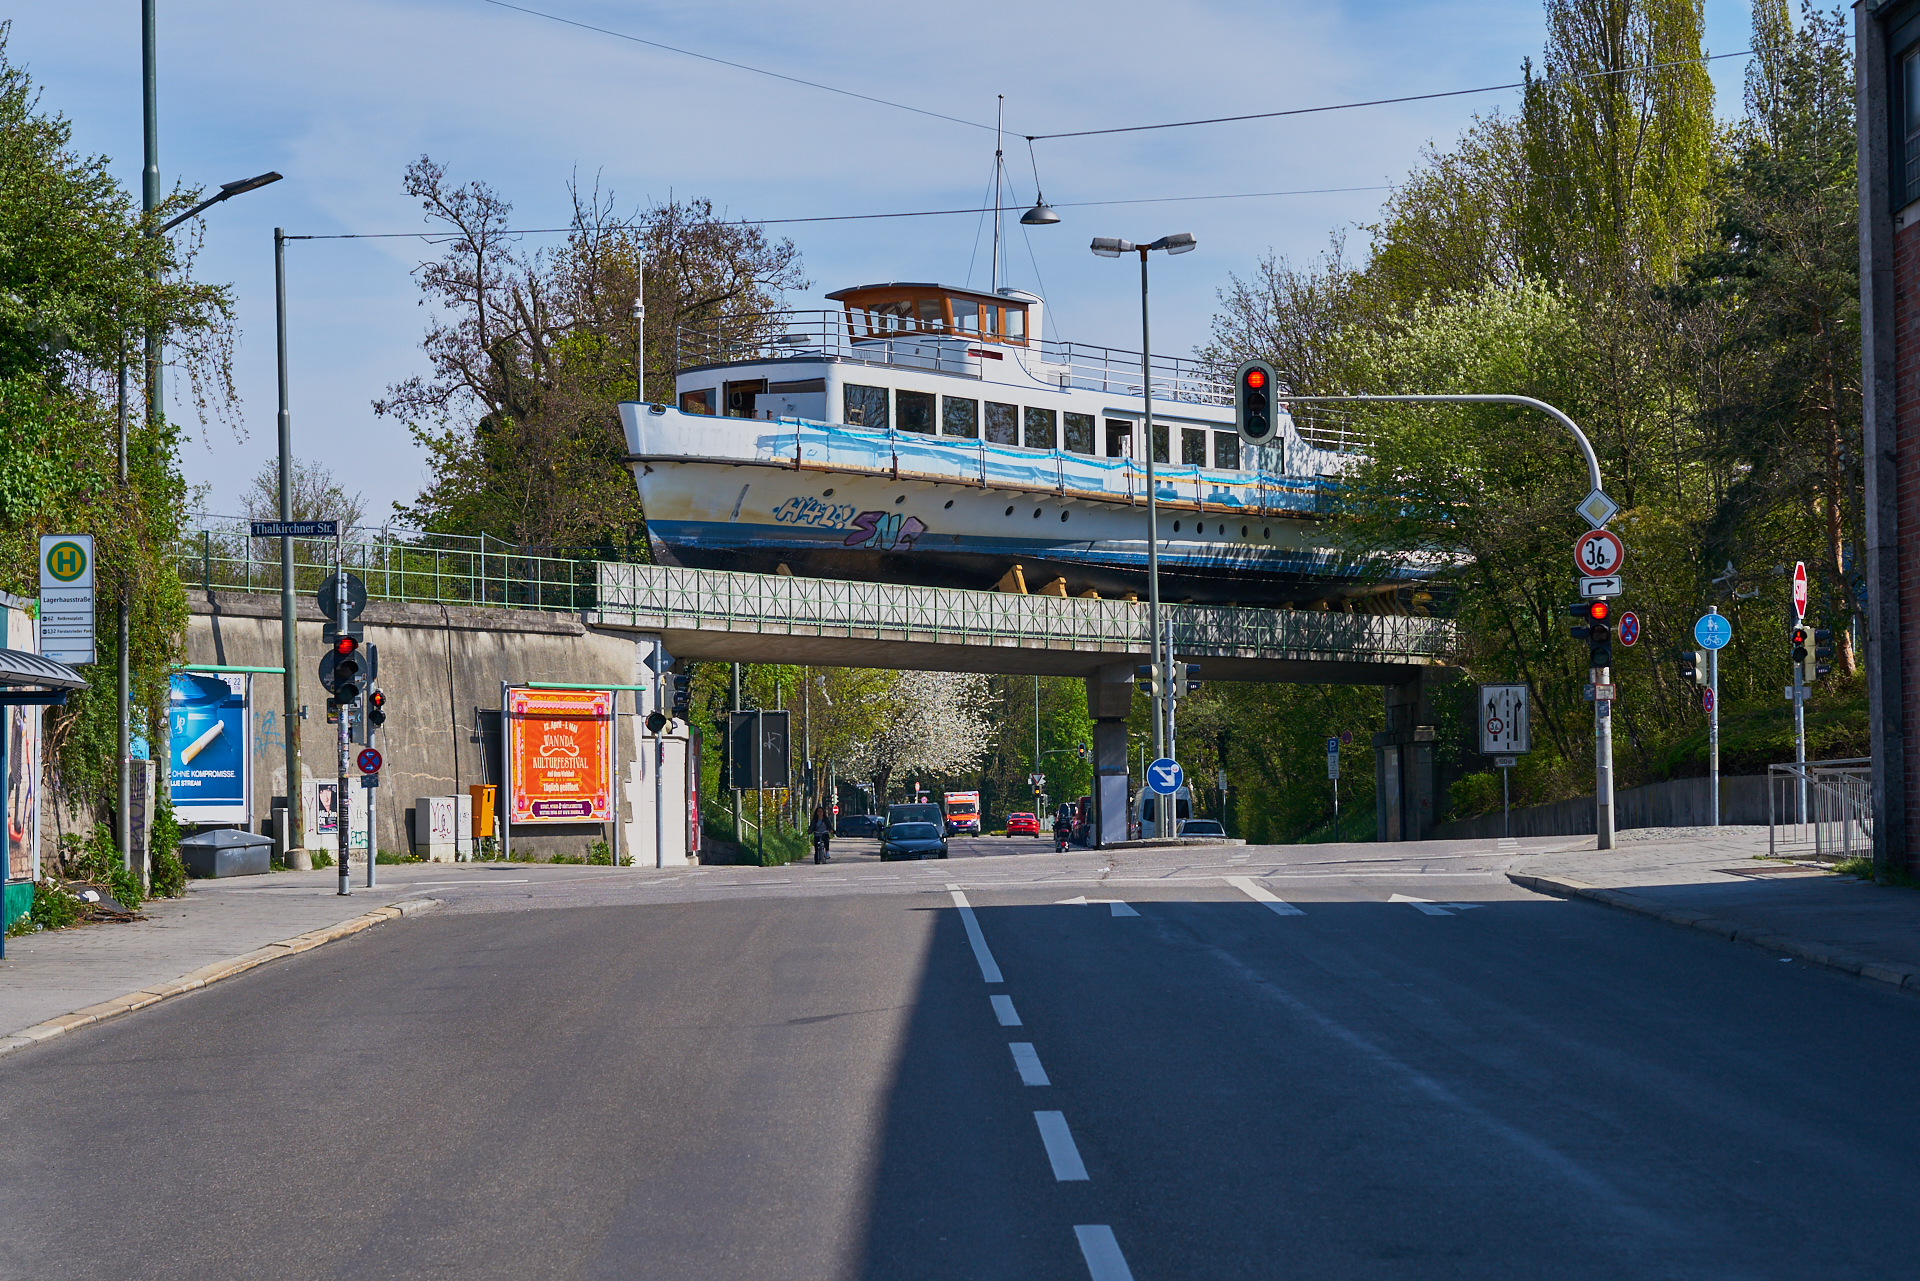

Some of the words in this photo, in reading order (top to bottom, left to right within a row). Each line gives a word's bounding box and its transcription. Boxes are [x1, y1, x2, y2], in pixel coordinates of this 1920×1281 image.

[255, 523, 315, 534] Thalkirchner
[317, 522, 332, 533] Str.
[57, 551, 76, 572] H
[43, 596, 91, 605] Lagerhausstraße
[543, 735, 574, 747] WANNDA
[532, 756, 589, 769] KULTURFESTIVAL
[172, 770, 190, 778] OHNE
[190, 770, 236, 778] KOMPROMISSE.
